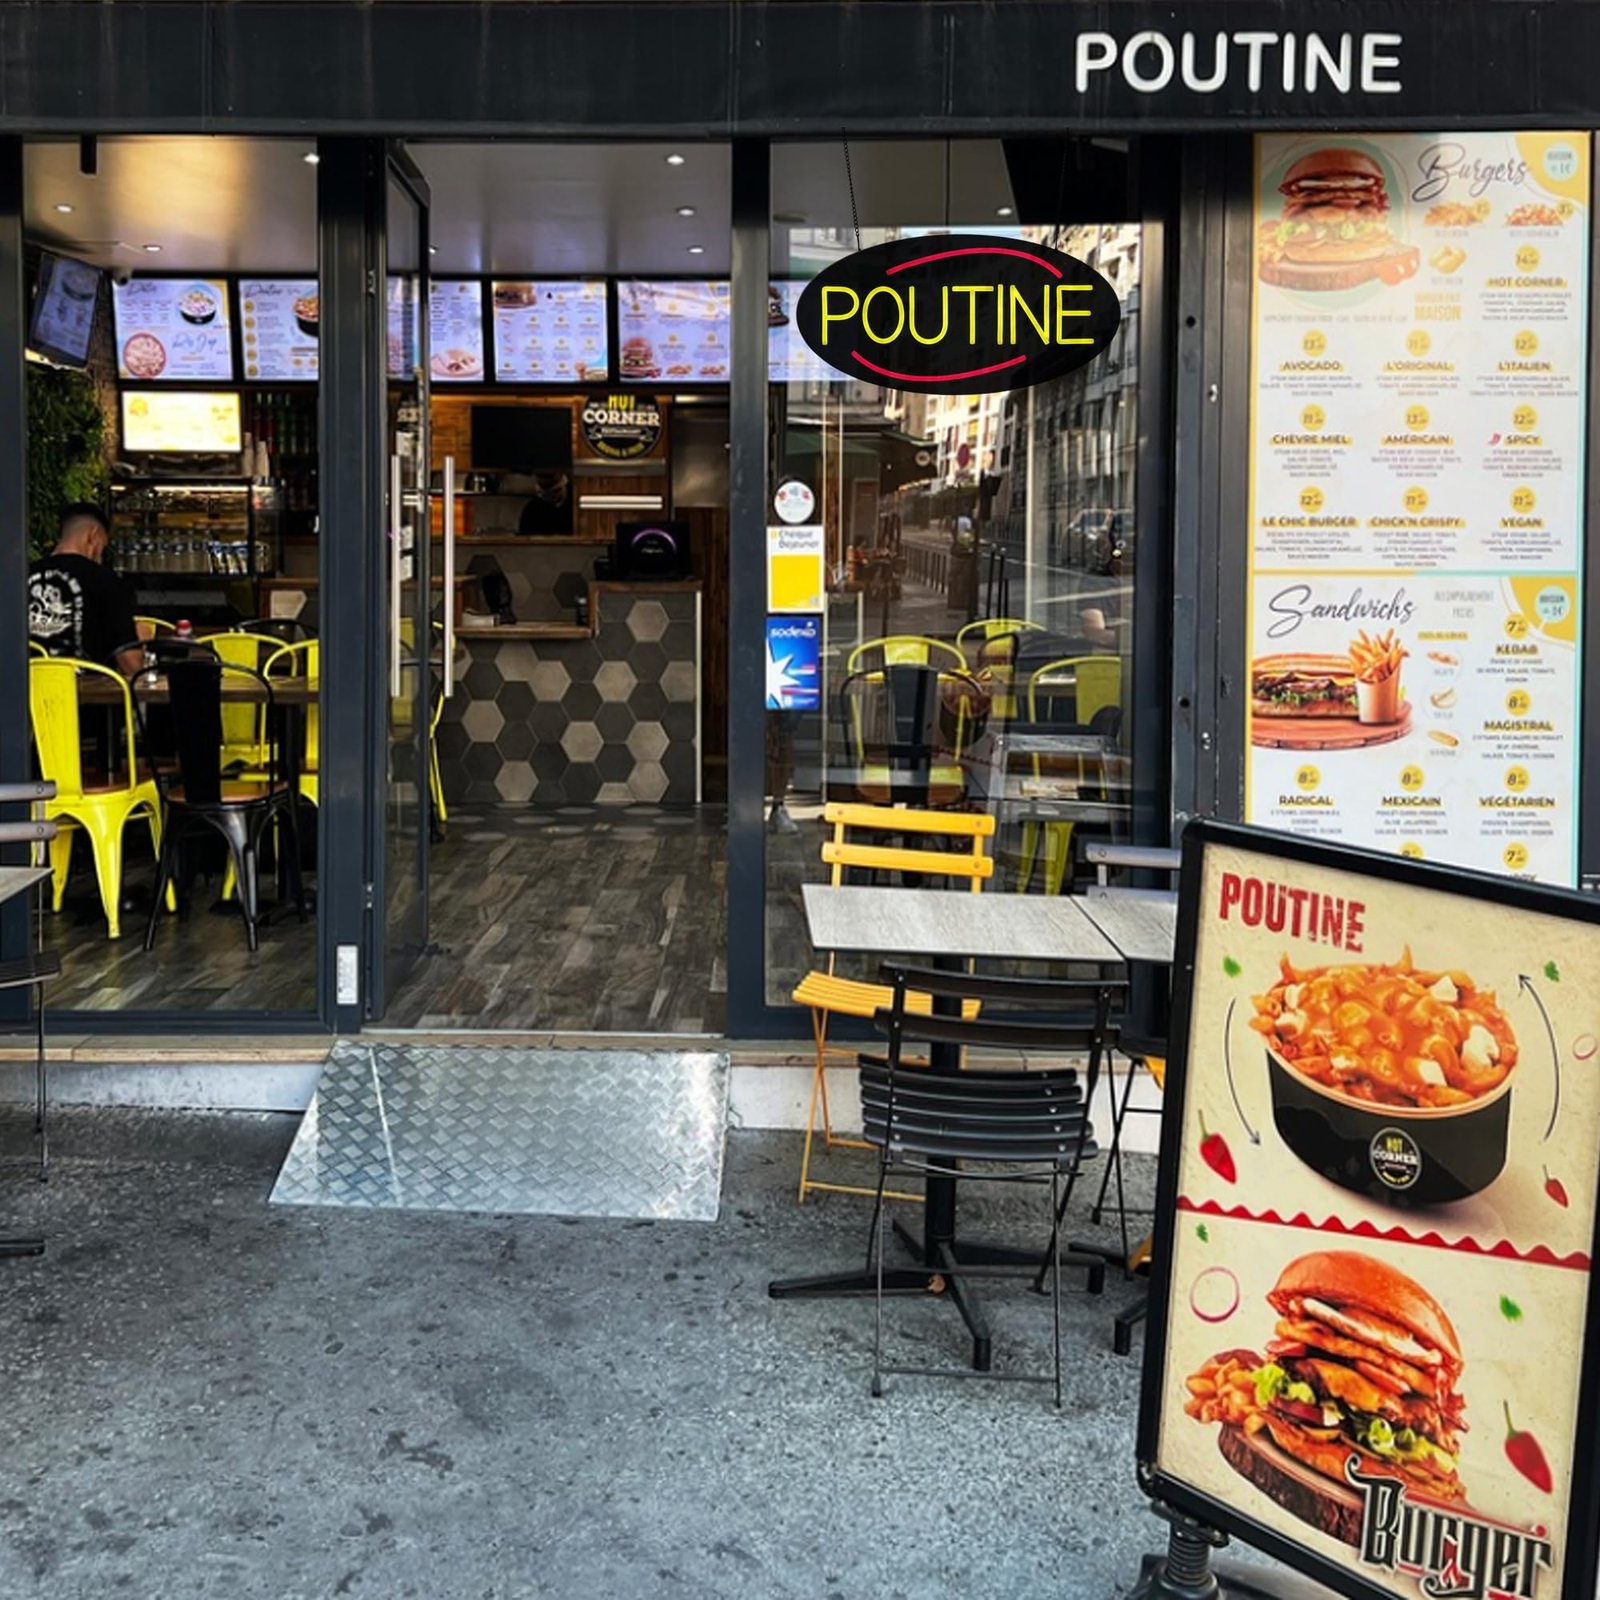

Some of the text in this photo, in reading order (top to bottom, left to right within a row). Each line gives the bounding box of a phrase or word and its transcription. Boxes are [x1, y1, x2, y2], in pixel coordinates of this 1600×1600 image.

[1075, 31, 1403, 93] POUTINE
[1412, 143, 1528, 203] Burgers
[1488, 277, 1564, 288] HOT CORNER
[821, 285, 1095, 346] POUTINE
[1282, 360, 1340, 371] AVOCADO
[1386, 361, 1450, 371] L'ORIGINAL
[1498, 361, 1550, 371] L'ITALIEN
[583, 409, 660, 426] CORNER
[1321, 434, 1349, 445] MIEL
[1506, 434, 1540, 444] SPICY
[1261, 516, 1357, 527] LE CHIC BURGER
[1370, 517, 1460, 528] CHICK'N CRISPY
[1500, 517, 1542, 528] VEGAN
[1266, 584, 1415, 639] Sandwichs
[770, 623, 817, 638] sodexo
[1495, 644, 1538, 656] KEBAB
[1484, 720, 1553, 731] MAGISTRAL
[1279, 796, 1333, 806] RADICAL
[1382, 796, 1441, 807] MEXICAIN
[1219, 872, 1366, 954] POUTINE
[1344, 1453, 1553, 1599] Burger
